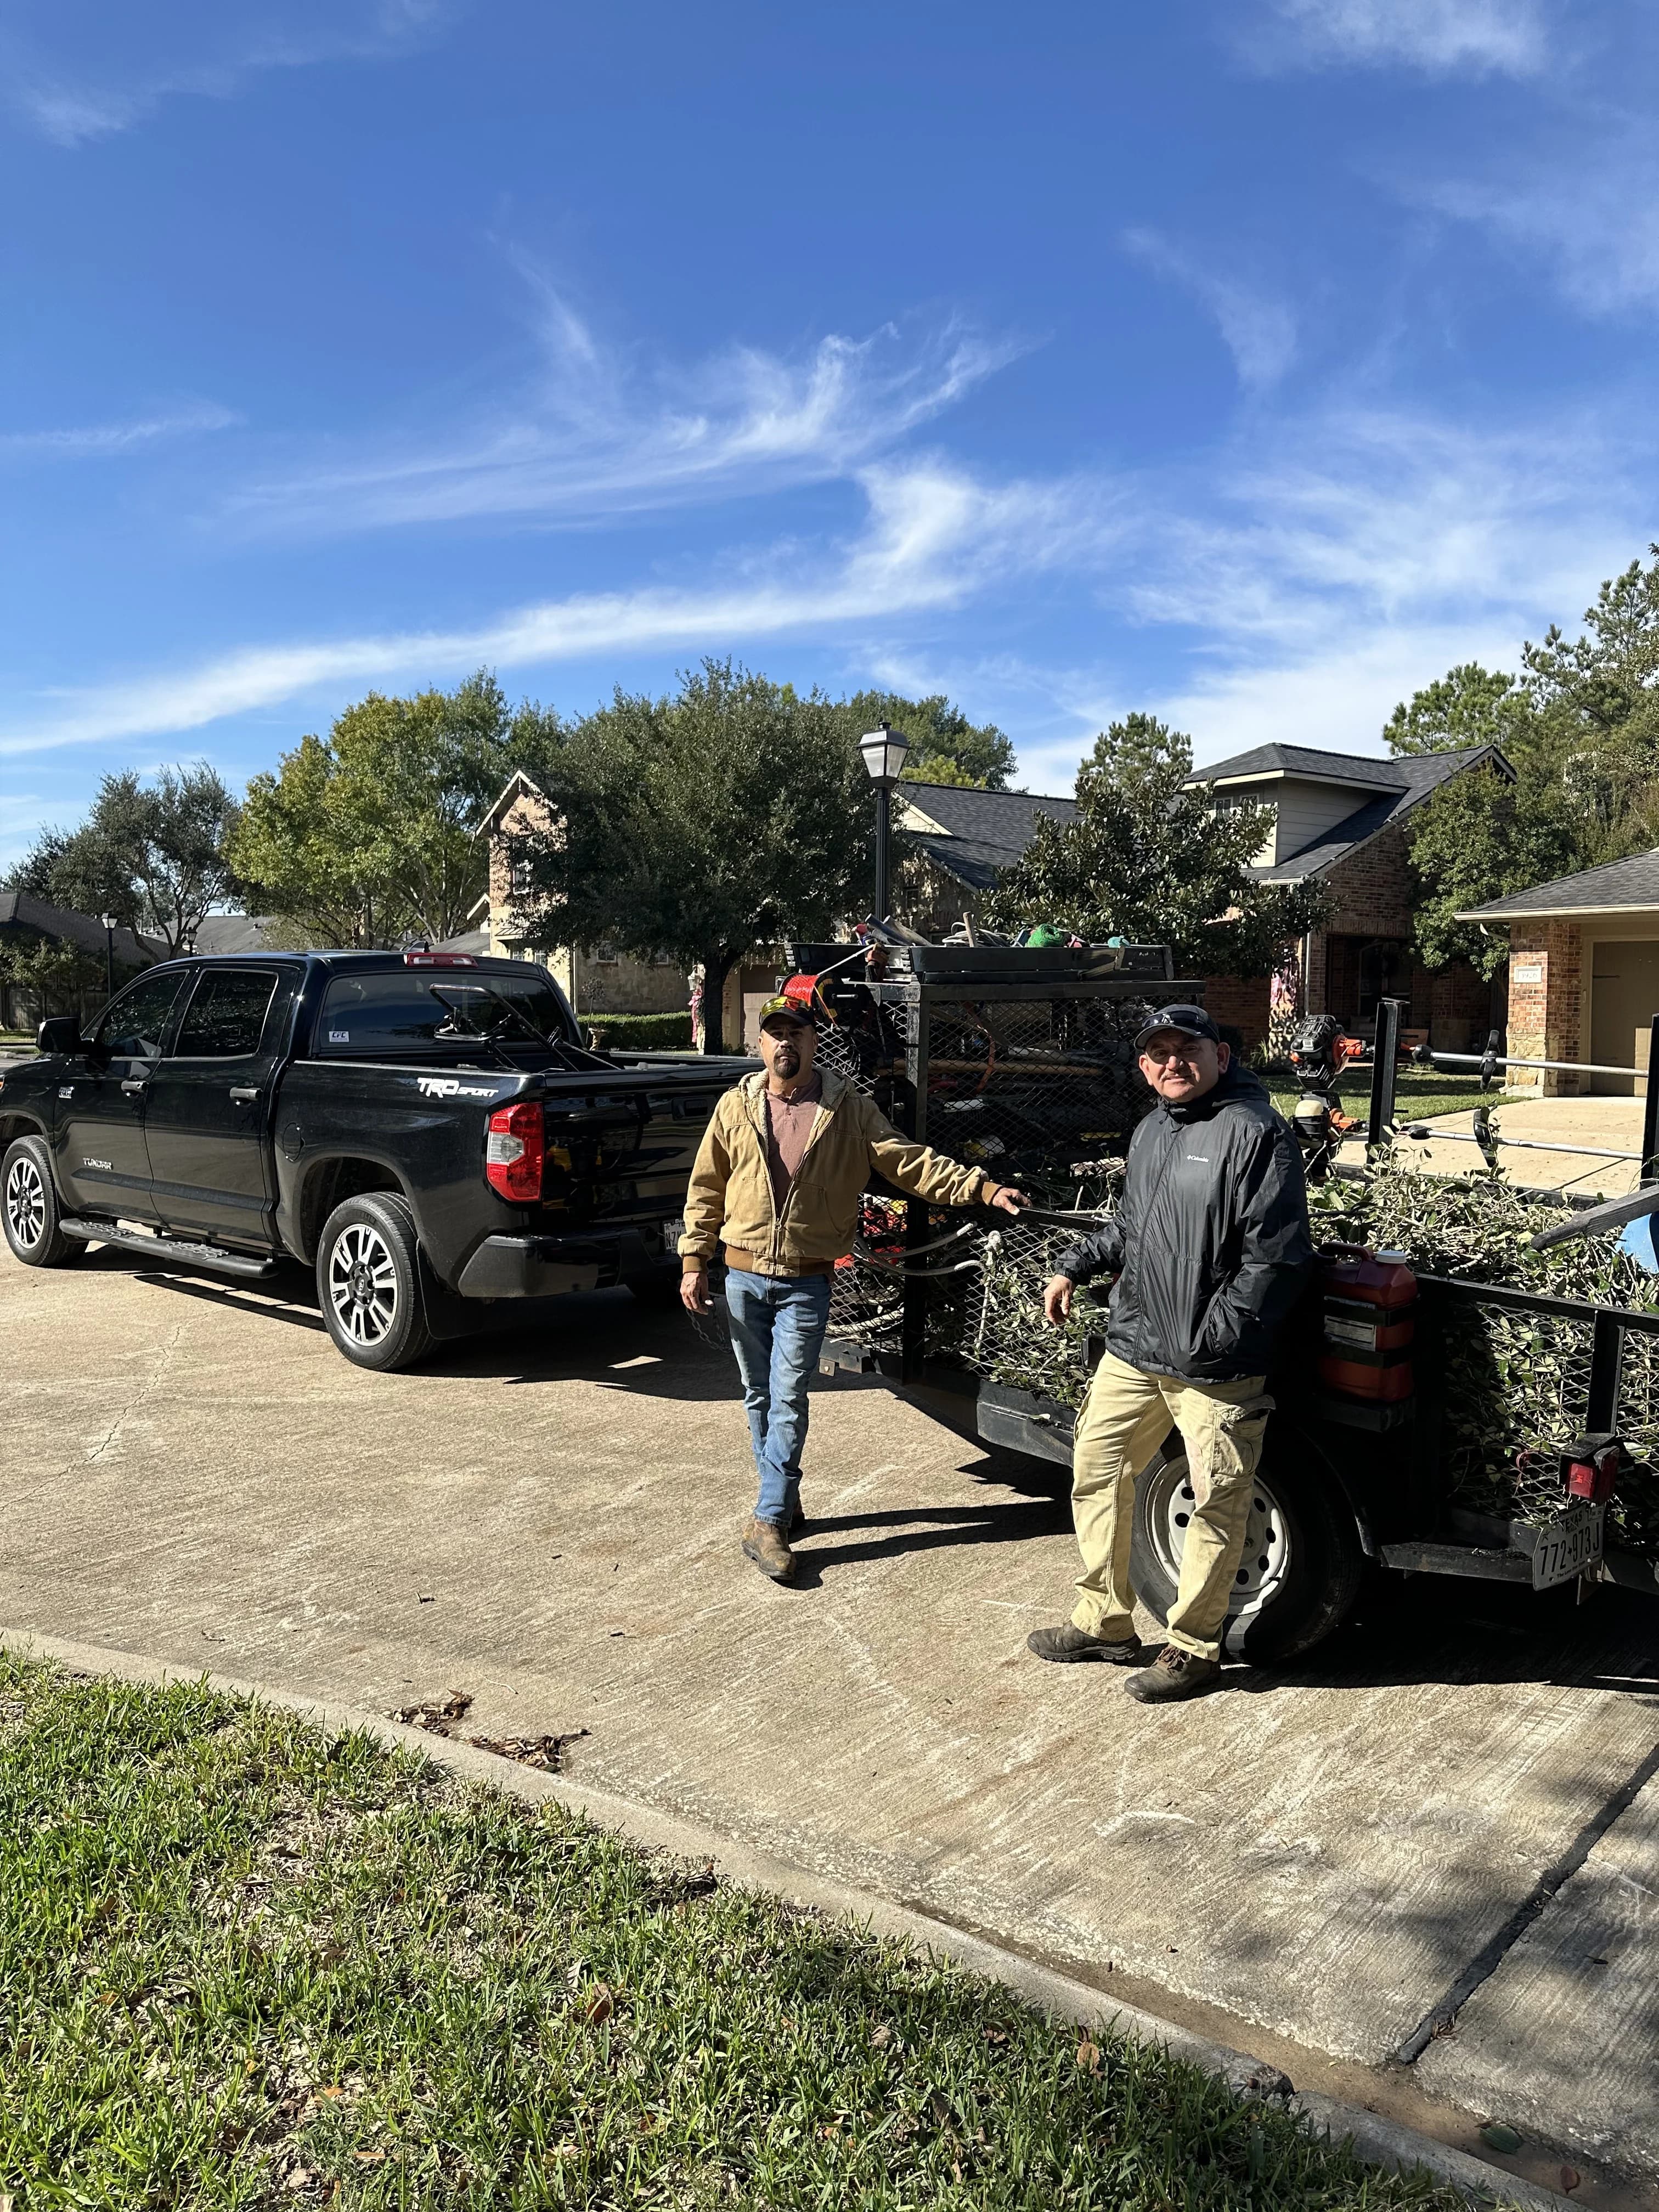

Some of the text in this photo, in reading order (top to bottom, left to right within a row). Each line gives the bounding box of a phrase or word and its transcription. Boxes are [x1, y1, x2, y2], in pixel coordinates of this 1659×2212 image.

[417, 1077, 499, 1098] TRD SPORT
[83, 1157, 112, 1170] TUNDRA
[1562, 1510, 1582, 1532] TEXAS
